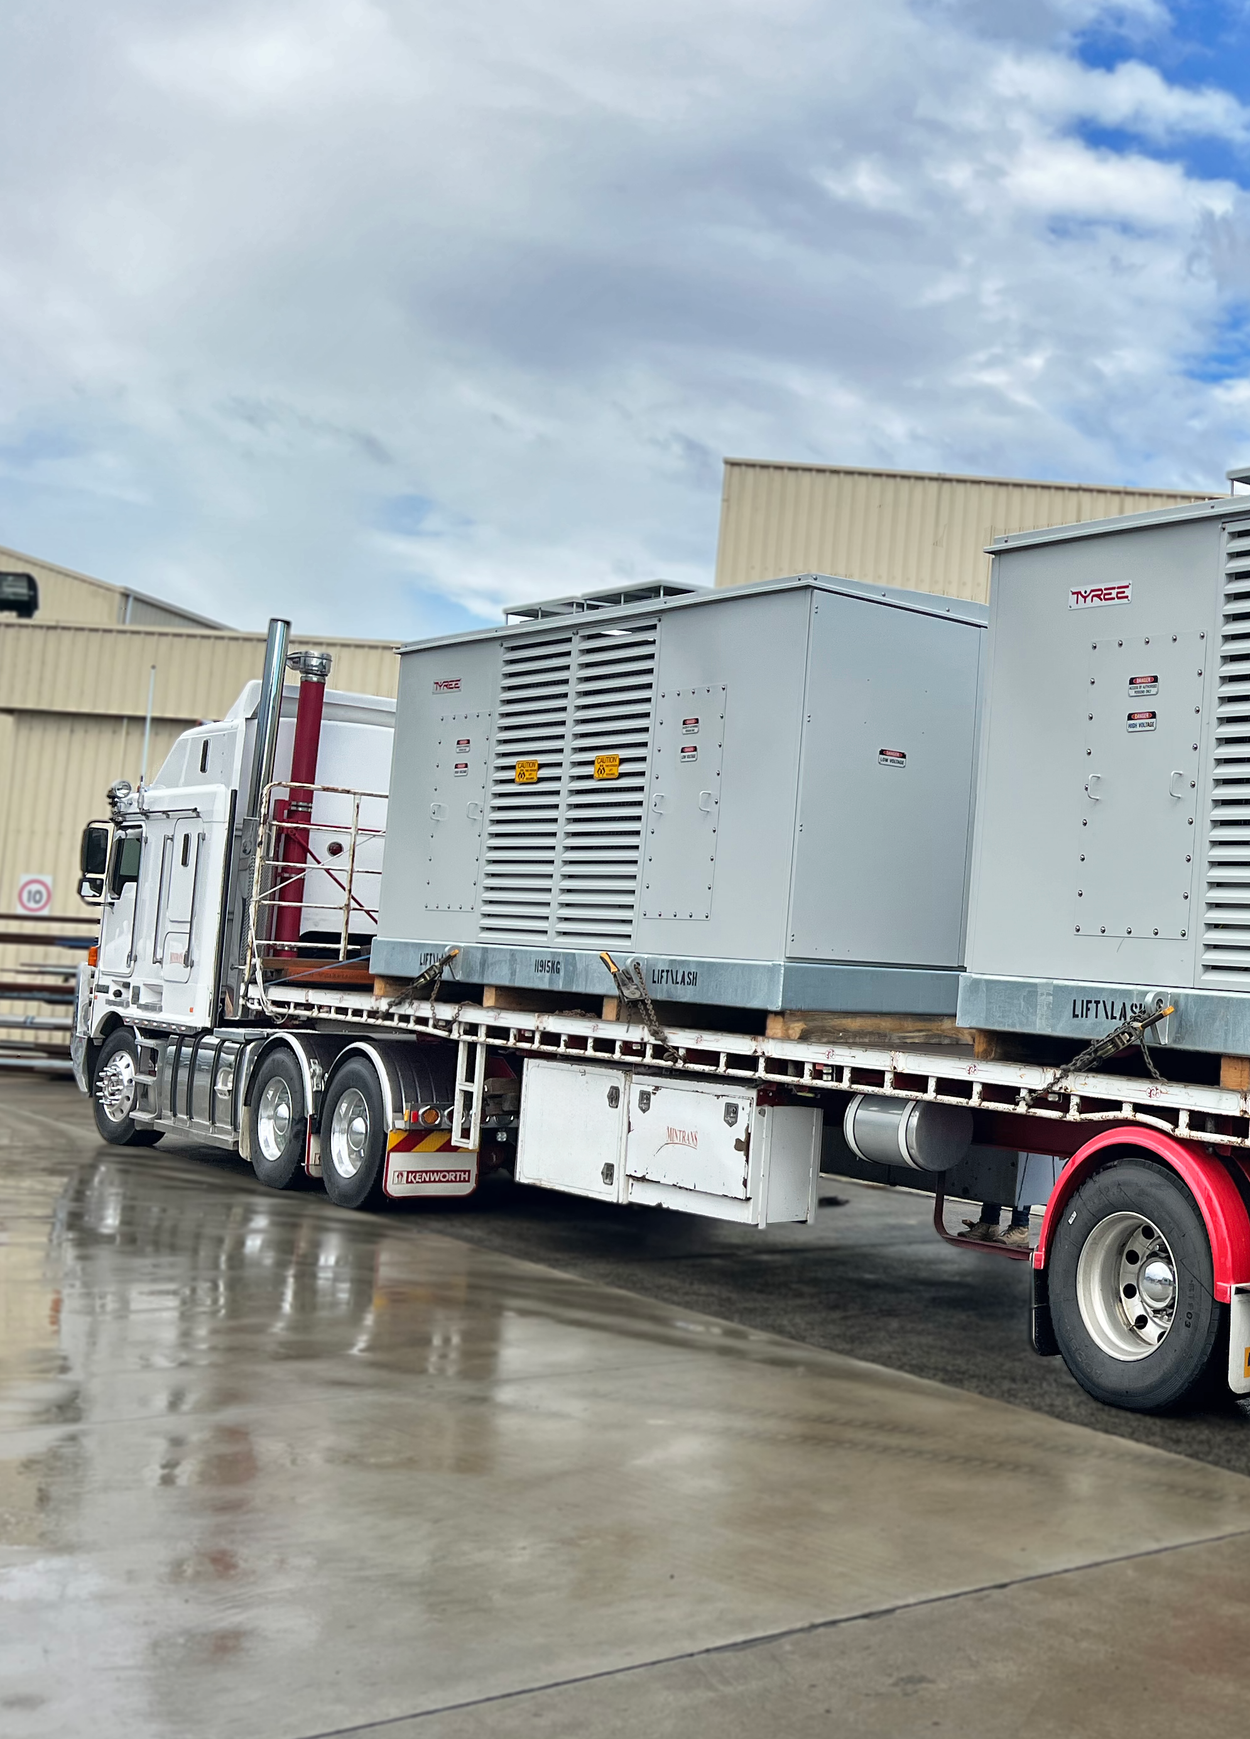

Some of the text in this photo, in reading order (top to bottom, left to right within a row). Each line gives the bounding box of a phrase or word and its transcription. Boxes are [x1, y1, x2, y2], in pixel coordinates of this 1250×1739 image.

[1071, 585, 1130, 605] TYREE
[433, 678, 462, 691] TYREE
[27, 889, 44, 905] 10
[408, 1171, 469, 1183] KENWORTH
